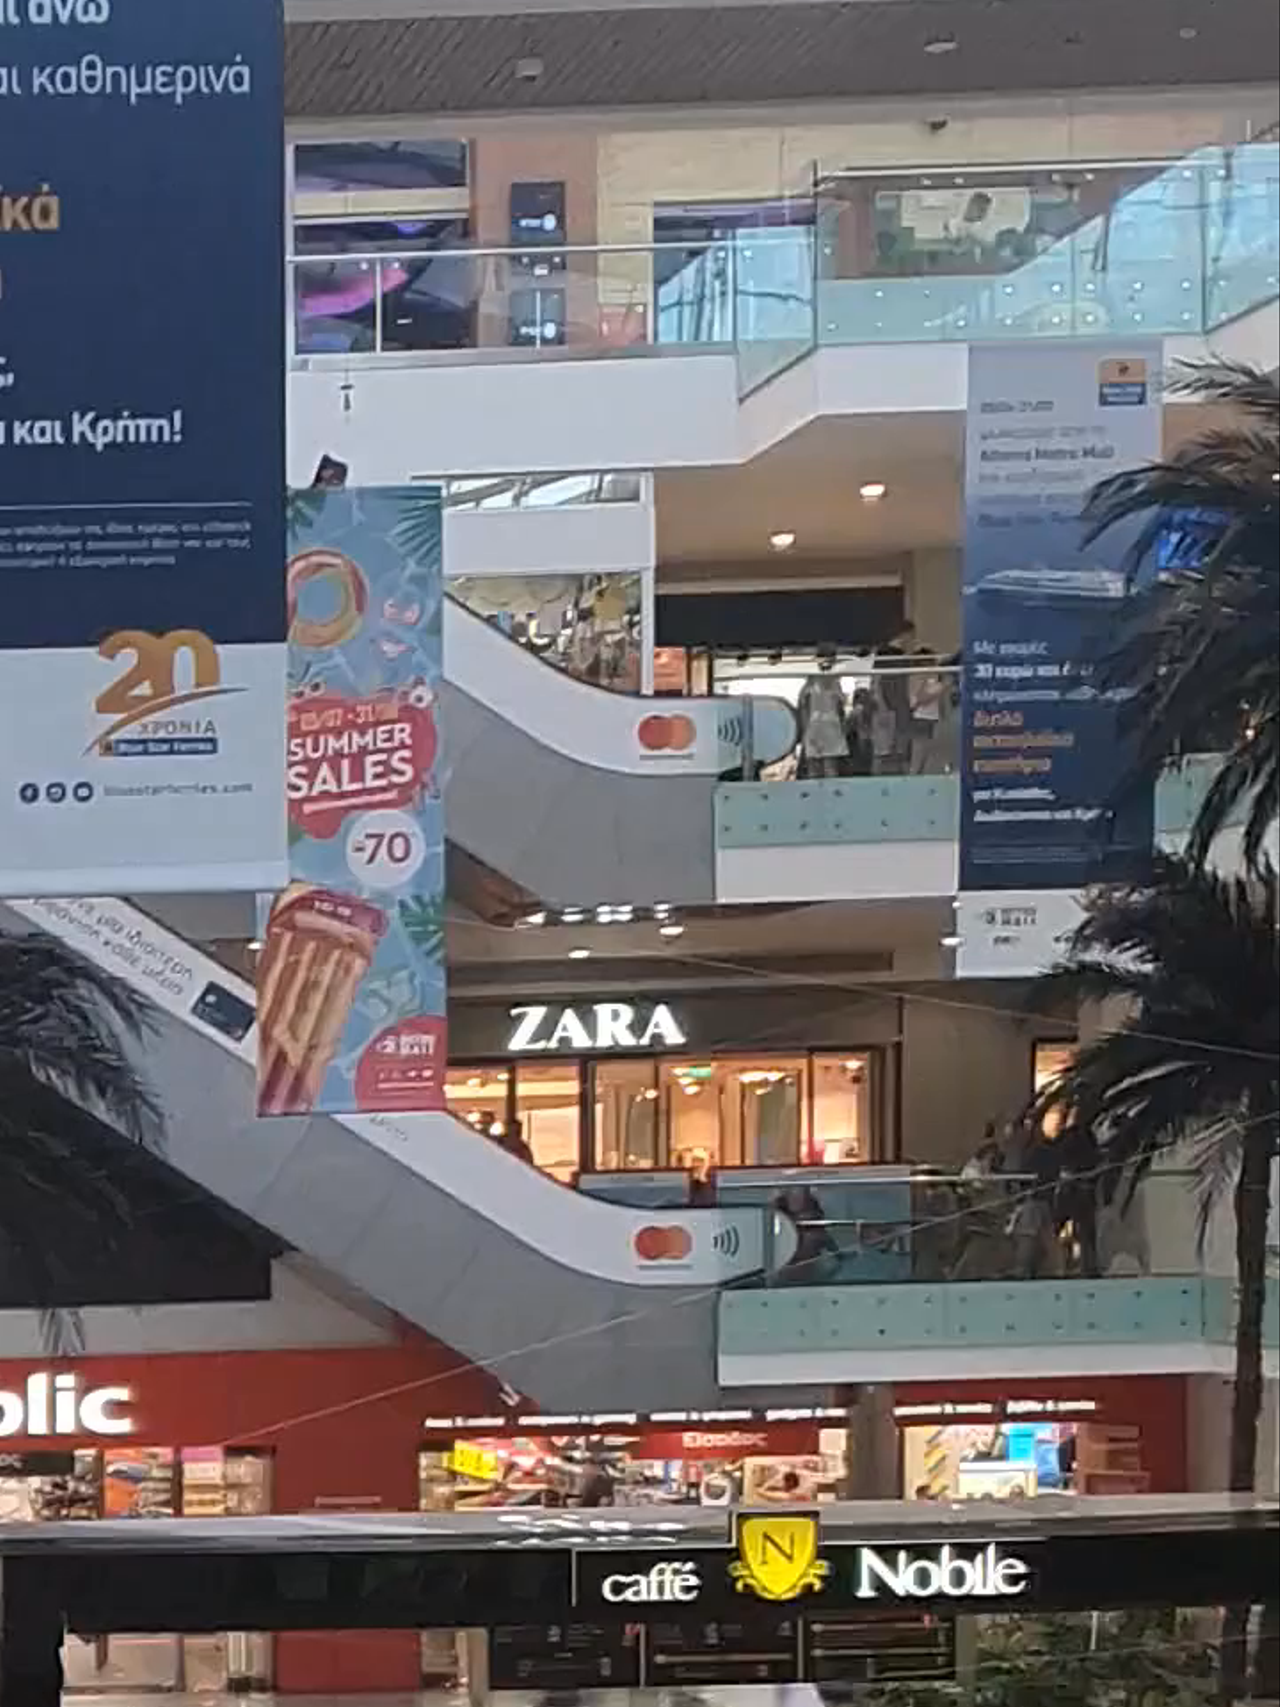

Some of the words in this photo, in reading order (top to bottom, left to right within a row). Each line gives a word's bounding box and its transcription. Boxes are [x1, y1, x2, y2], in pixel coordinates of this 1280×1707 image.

[33, 53, 251, 106] καθημερινά
[14, 417, 65, 446] και
[72, 410, 182, 454] Κρήτη!
[95, 629, 220, 713] 20
[288, 723, 412, 760] SUMMER
[287, 749, 413, 799] SALES
[507, 1002, 687, 1052] ZARA
[602, 1561, 701, 1602] caffé
[757, 1532, 794, 1564] N
[855, 1542, 1028, 1598] Nobile
